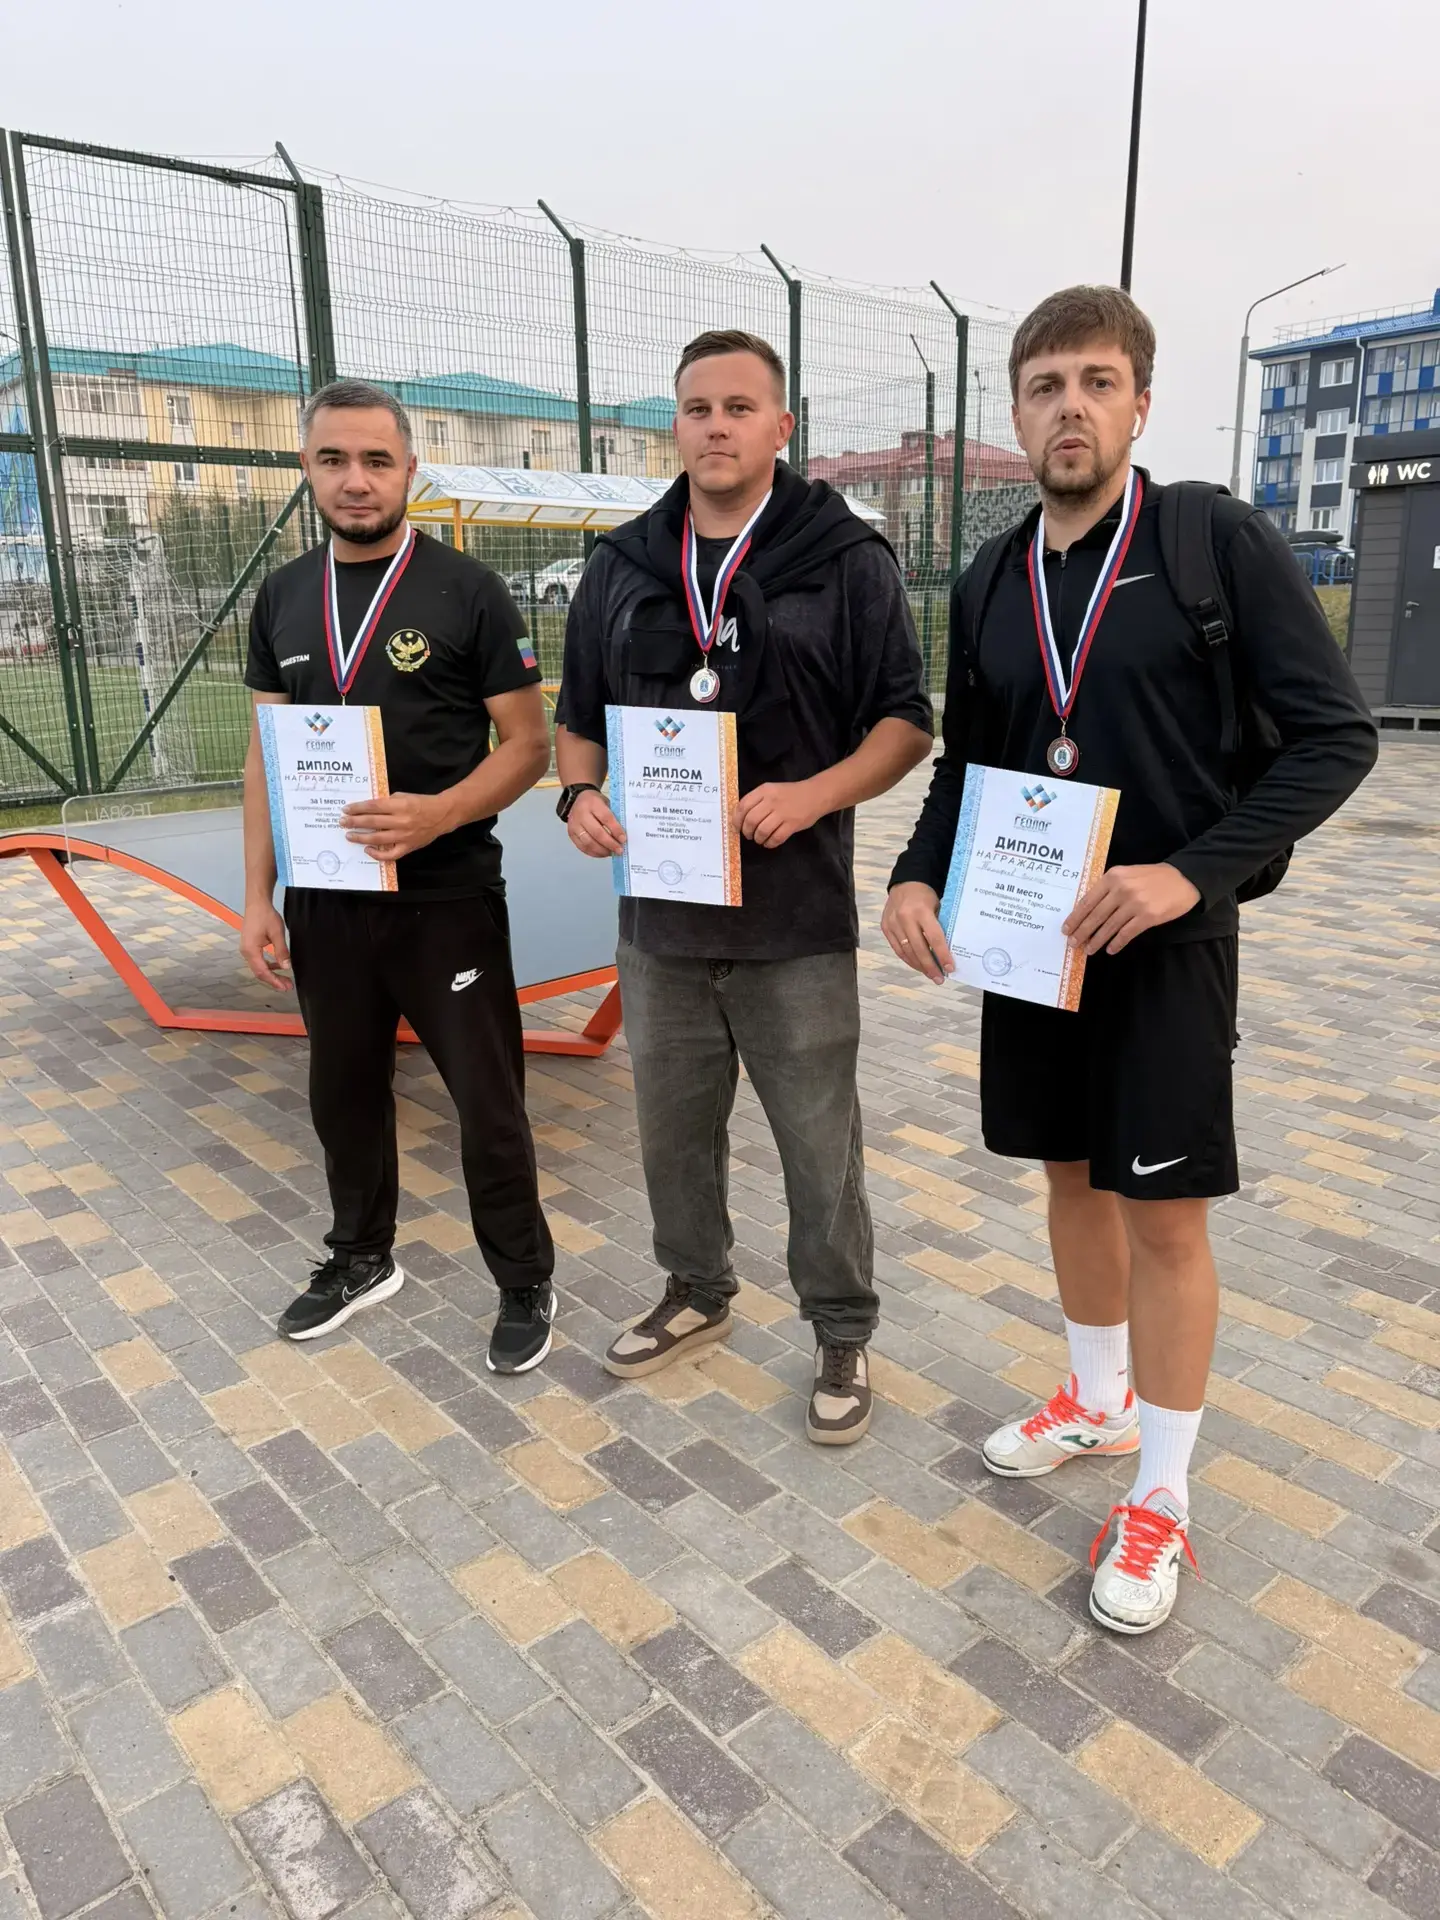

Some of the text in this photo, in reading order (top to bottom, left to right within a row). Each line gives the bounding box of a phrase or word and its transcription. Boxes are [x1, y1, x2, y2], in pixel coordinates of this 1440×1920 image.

[1397, 462, 1431, 480] WC
[280, 653, 310, 668] DAGESTAN
[305, 740, 336, 751] ГЕОЛОГ
[654, 746, 686, 757] ГЕОЛОГ
[297, 760, 353, 771] ДИПЛОМ
[284, 774, 369, 783] НАГРАЖДАЕТСЯ
[643, 766, 702, 780] ДИПЛОМ
[628, 781, 718, 793] НАГРАЖДАЕТСЯ
[1014, 816, 1052, 831] ГЕОЛОГ
[995, 836, 1064, 861] ДИПЛОМ
[976, 849, 1080, 879] НАГРАЖДАЕТСЯ
[995, 883, 1044, 900] за III место
[1027, 899, 1061, 913] Тарко-Сале
[980, 910, 1001, 920] Вместе
[995, 907, 1032, 921] НАШЕ ЛЕТО
[455, 968, 477, 983] NIKE
